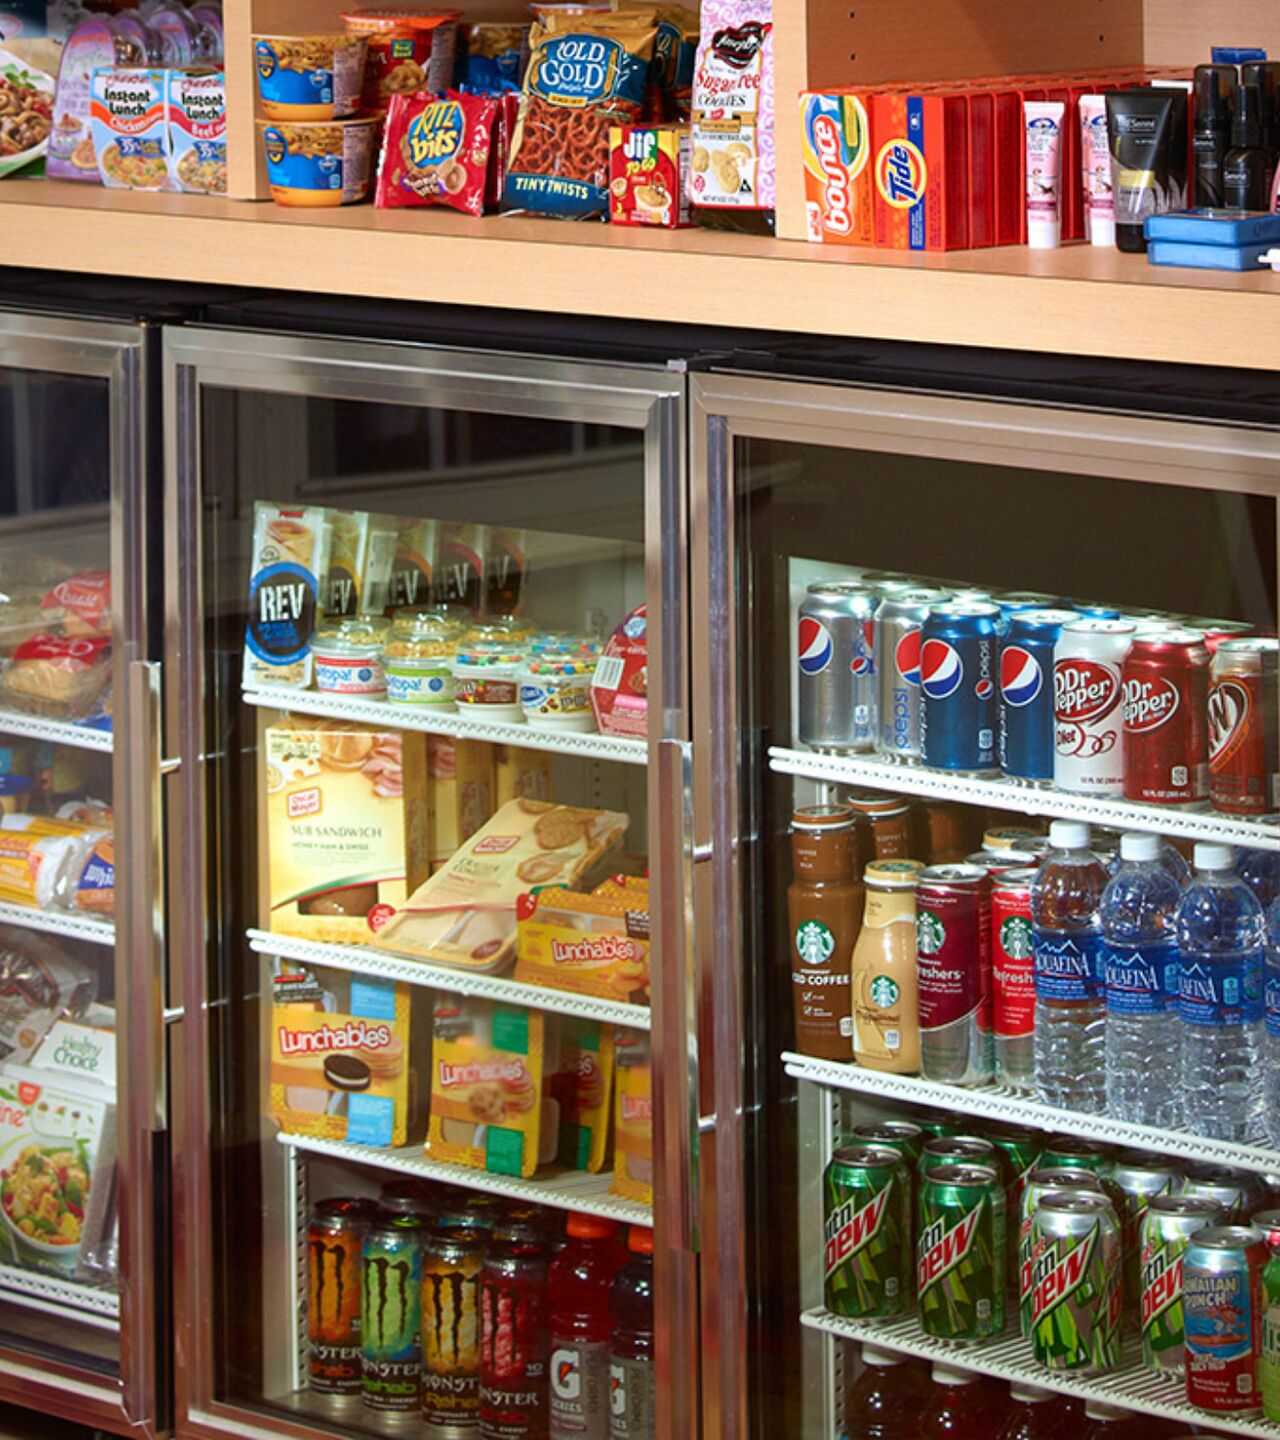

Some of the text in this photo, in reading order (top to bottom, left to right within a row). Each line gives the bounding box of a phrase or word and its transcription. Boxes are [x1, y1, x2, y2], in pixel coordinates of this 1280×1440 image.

[540, 60, 604, 90] GOLD
[104, 87, 151, 103] Instant
[182, 91, 223, 106] Instant
[110, 103, 146, 116] Lunch
[187, 107, 219, 120] Lunch
[413, 101, 459, 136] RITZ
[411, 130, 458, 163] bits
[817, 118, 850, 232] bounce
[889, 146, 917, 201] Tide
[516, 178, 588, 200] TINY TWISTS
[260, 583, 306, 623] REV
[331, 579, 352, 614] EV
[979, 641, 989, 679] pepsi
[1064, 668, 1091, 692] Dr
[1129, 679, 1153, 703] Dr
[1055, 675, 1111, 714] Pepper
[893, 688, 909, 750] pepsi
[291, 826, 383, 839] SUB SANDWICH
[552, 938, 634, 962] Lunchables
[808, 974, 850, 985] COFFEE
[918, 966, 961, 980] reshers
[993, 966, 1034, 988] Refresh
[280, 1021, 390, 1054] Lunchables
[53, 1047, 99, 1071] Choice
[312, 1346, 361, 1360] NSTER
[423, 1374, 478, 1391] MONST
[551, 1349, 581, 1399] G
[426, 1392, 479, 1408] Reha
[480, 1386, 539, 1406] NSTER
